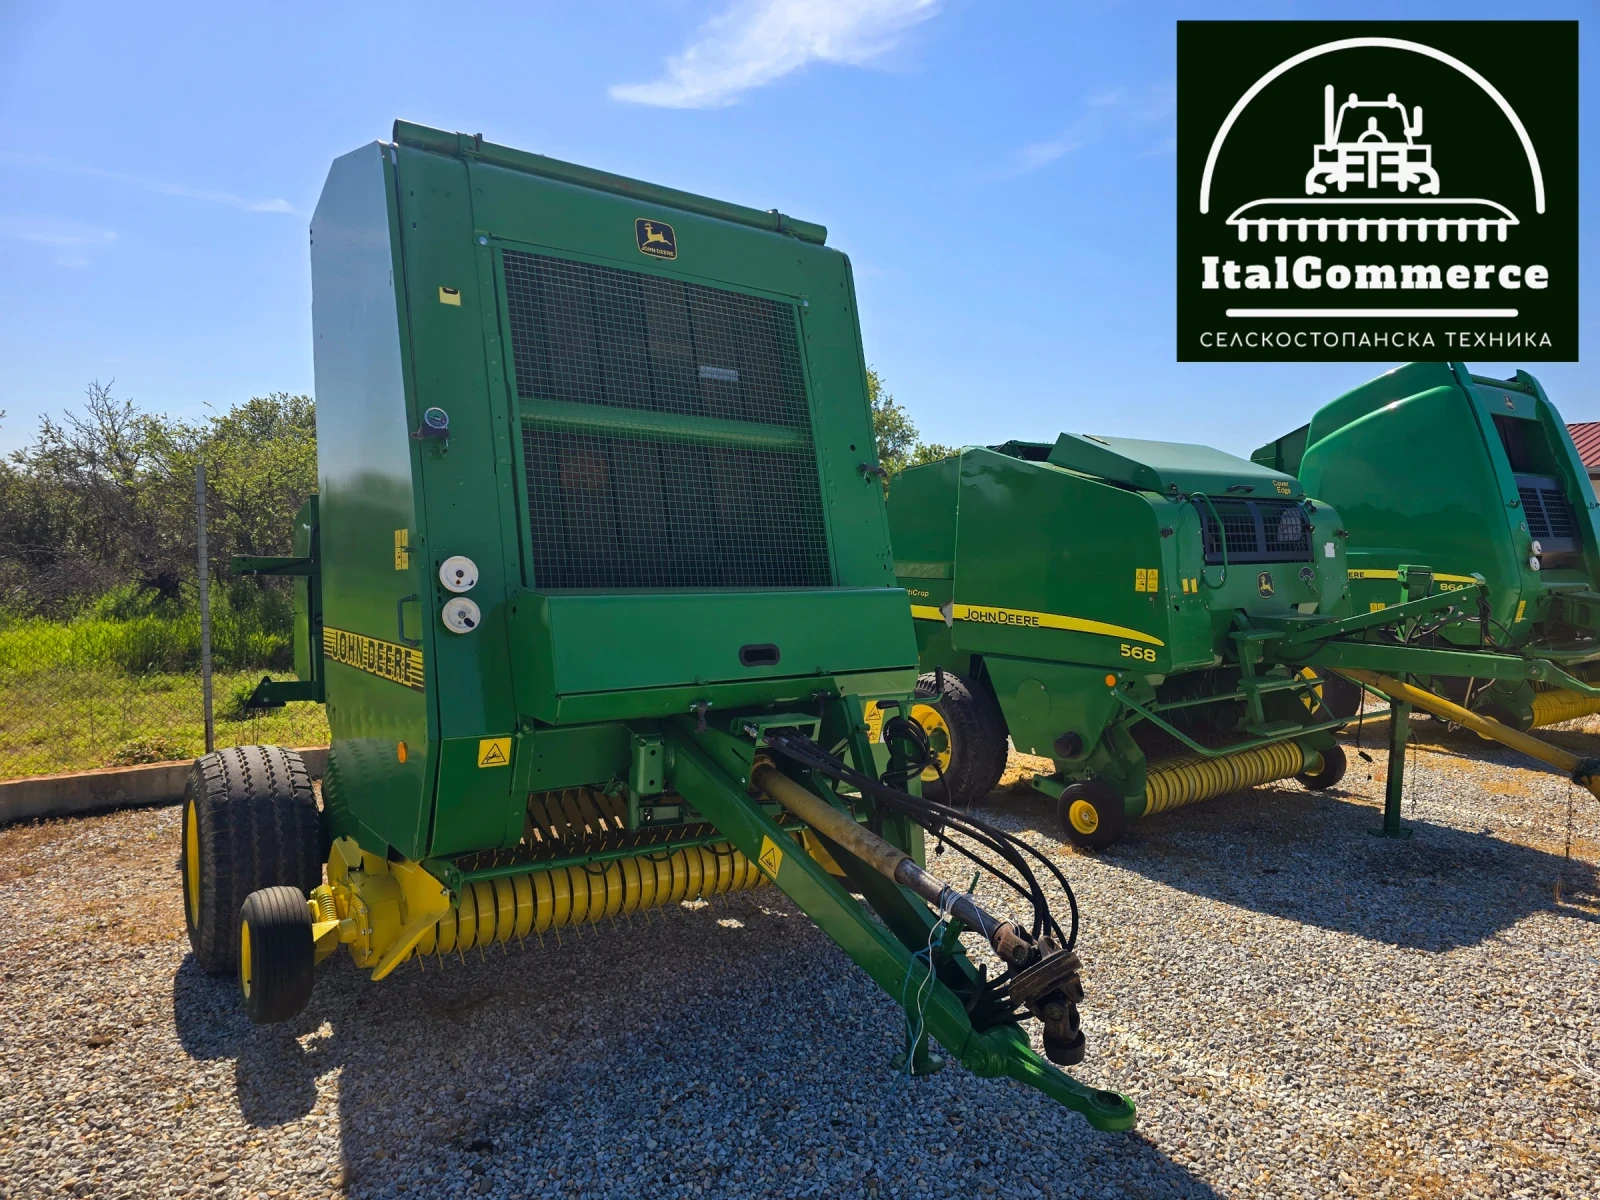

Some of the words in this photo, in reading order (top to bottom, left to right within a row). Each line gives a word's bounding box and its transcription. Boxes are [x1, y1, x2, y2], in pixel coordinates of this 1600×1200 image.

[641, 245, 656, 253] JOHN
[656, 248, 674, 257] DEERE
[1277, 486, 1292, 495] Edge
[1348, 571, 1365, 579] ERE
[907, 589, 930, 598] tiCrop
[964, 608, 997, 622] JOHN
[998, 611, 1040, 627] DEERE
[332, 631, 364, 668] JOHN
[366, 640, 412, 685] DEERE
[1120, 643, 1157, 663] 568
